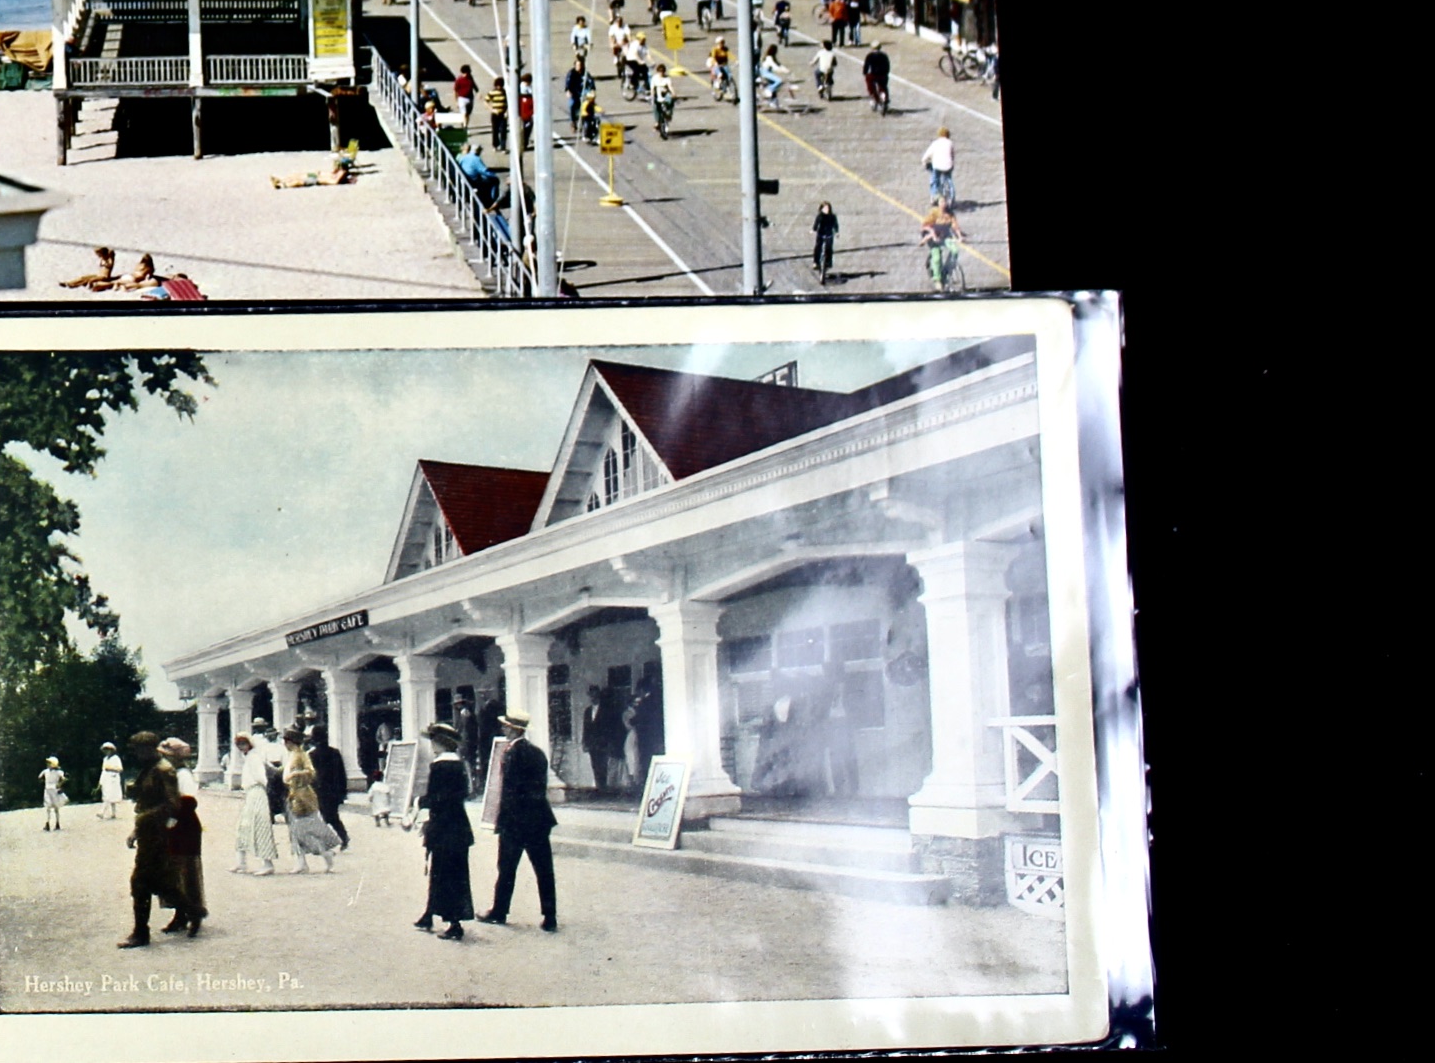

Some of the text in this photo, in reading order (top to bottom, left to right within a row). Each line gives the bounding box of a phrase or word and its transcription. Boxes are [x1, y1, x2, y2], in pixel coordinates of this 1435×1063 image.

[1022, 844, 1058, 868] ICE
[24, 971, 304, 997] Hershey Park Cafe, Hershey, Pa.
